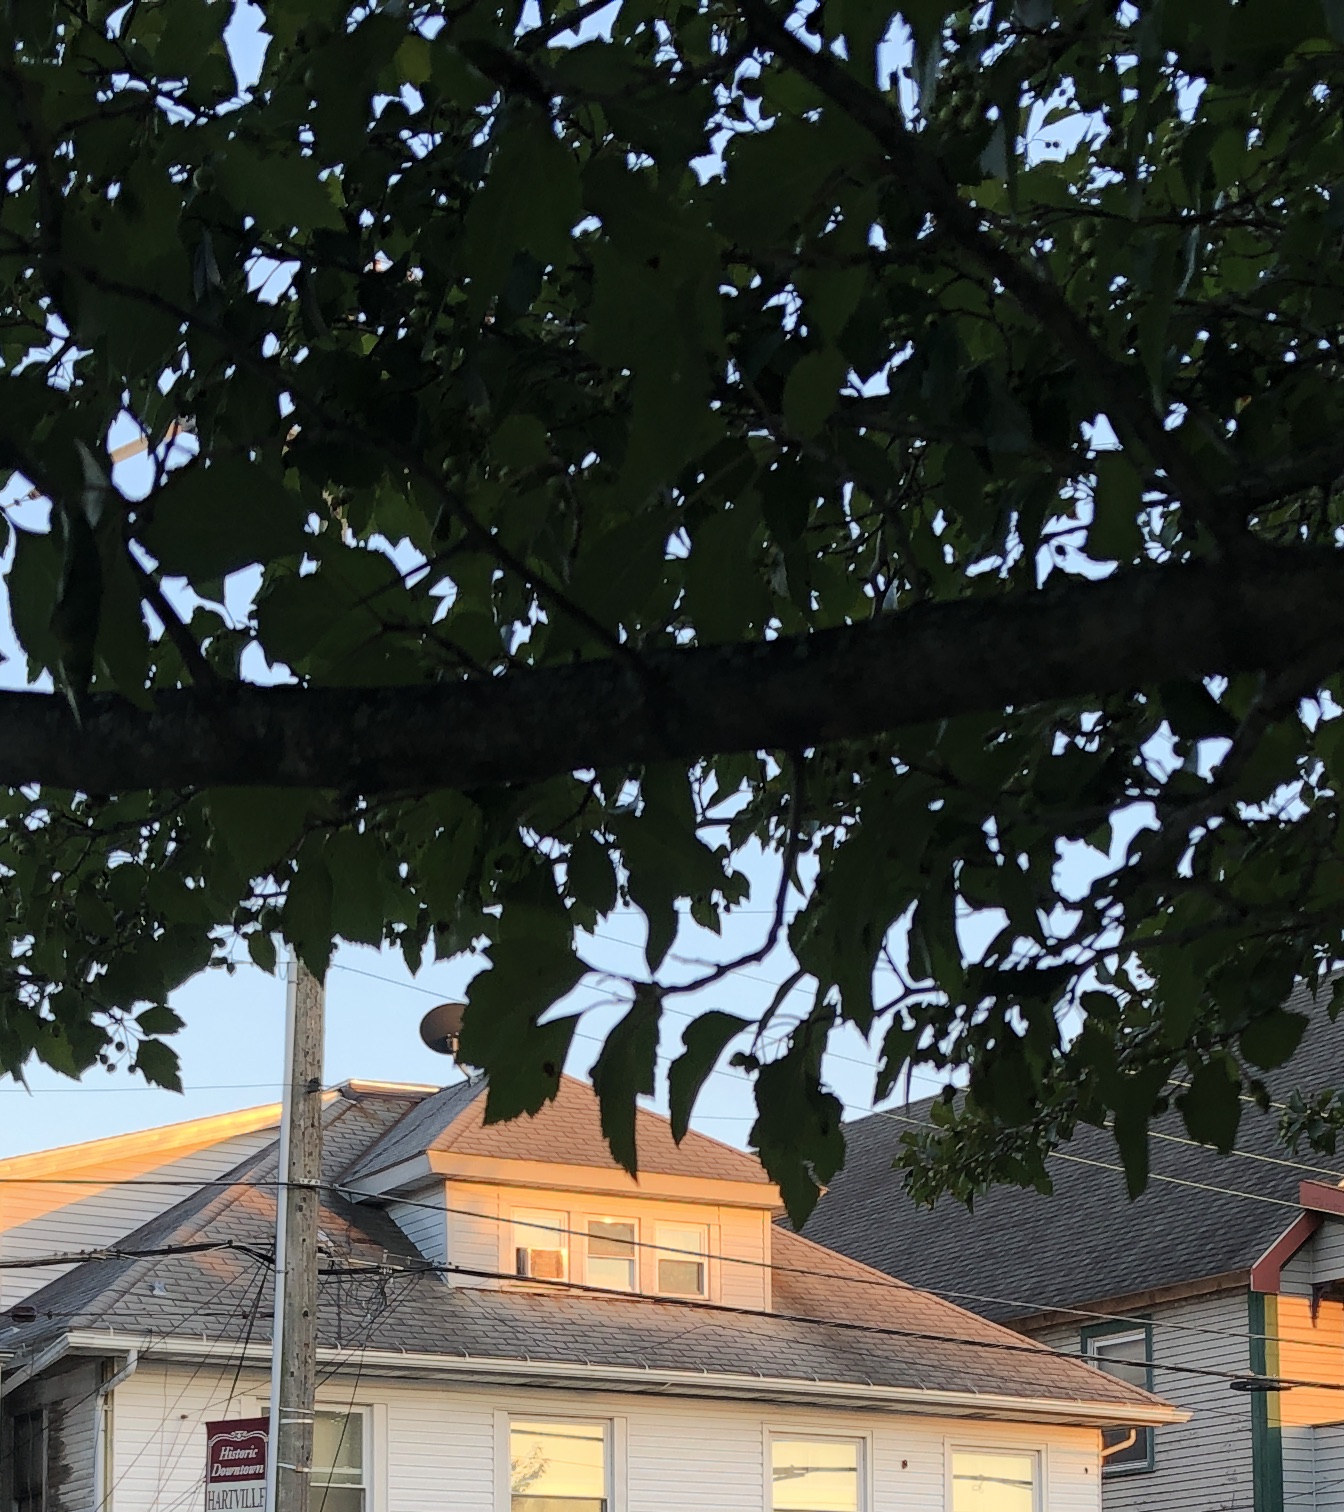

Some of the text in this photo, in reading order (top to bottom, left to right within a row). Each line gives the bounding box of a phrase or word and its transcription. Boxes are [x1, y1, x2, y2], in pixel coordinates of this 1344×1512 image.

[219, 1446, 258, 1460] Historic
[212, 1464, 264, 1477] Downtown
[208, 1487, 265, 1511] HARTVILLE
